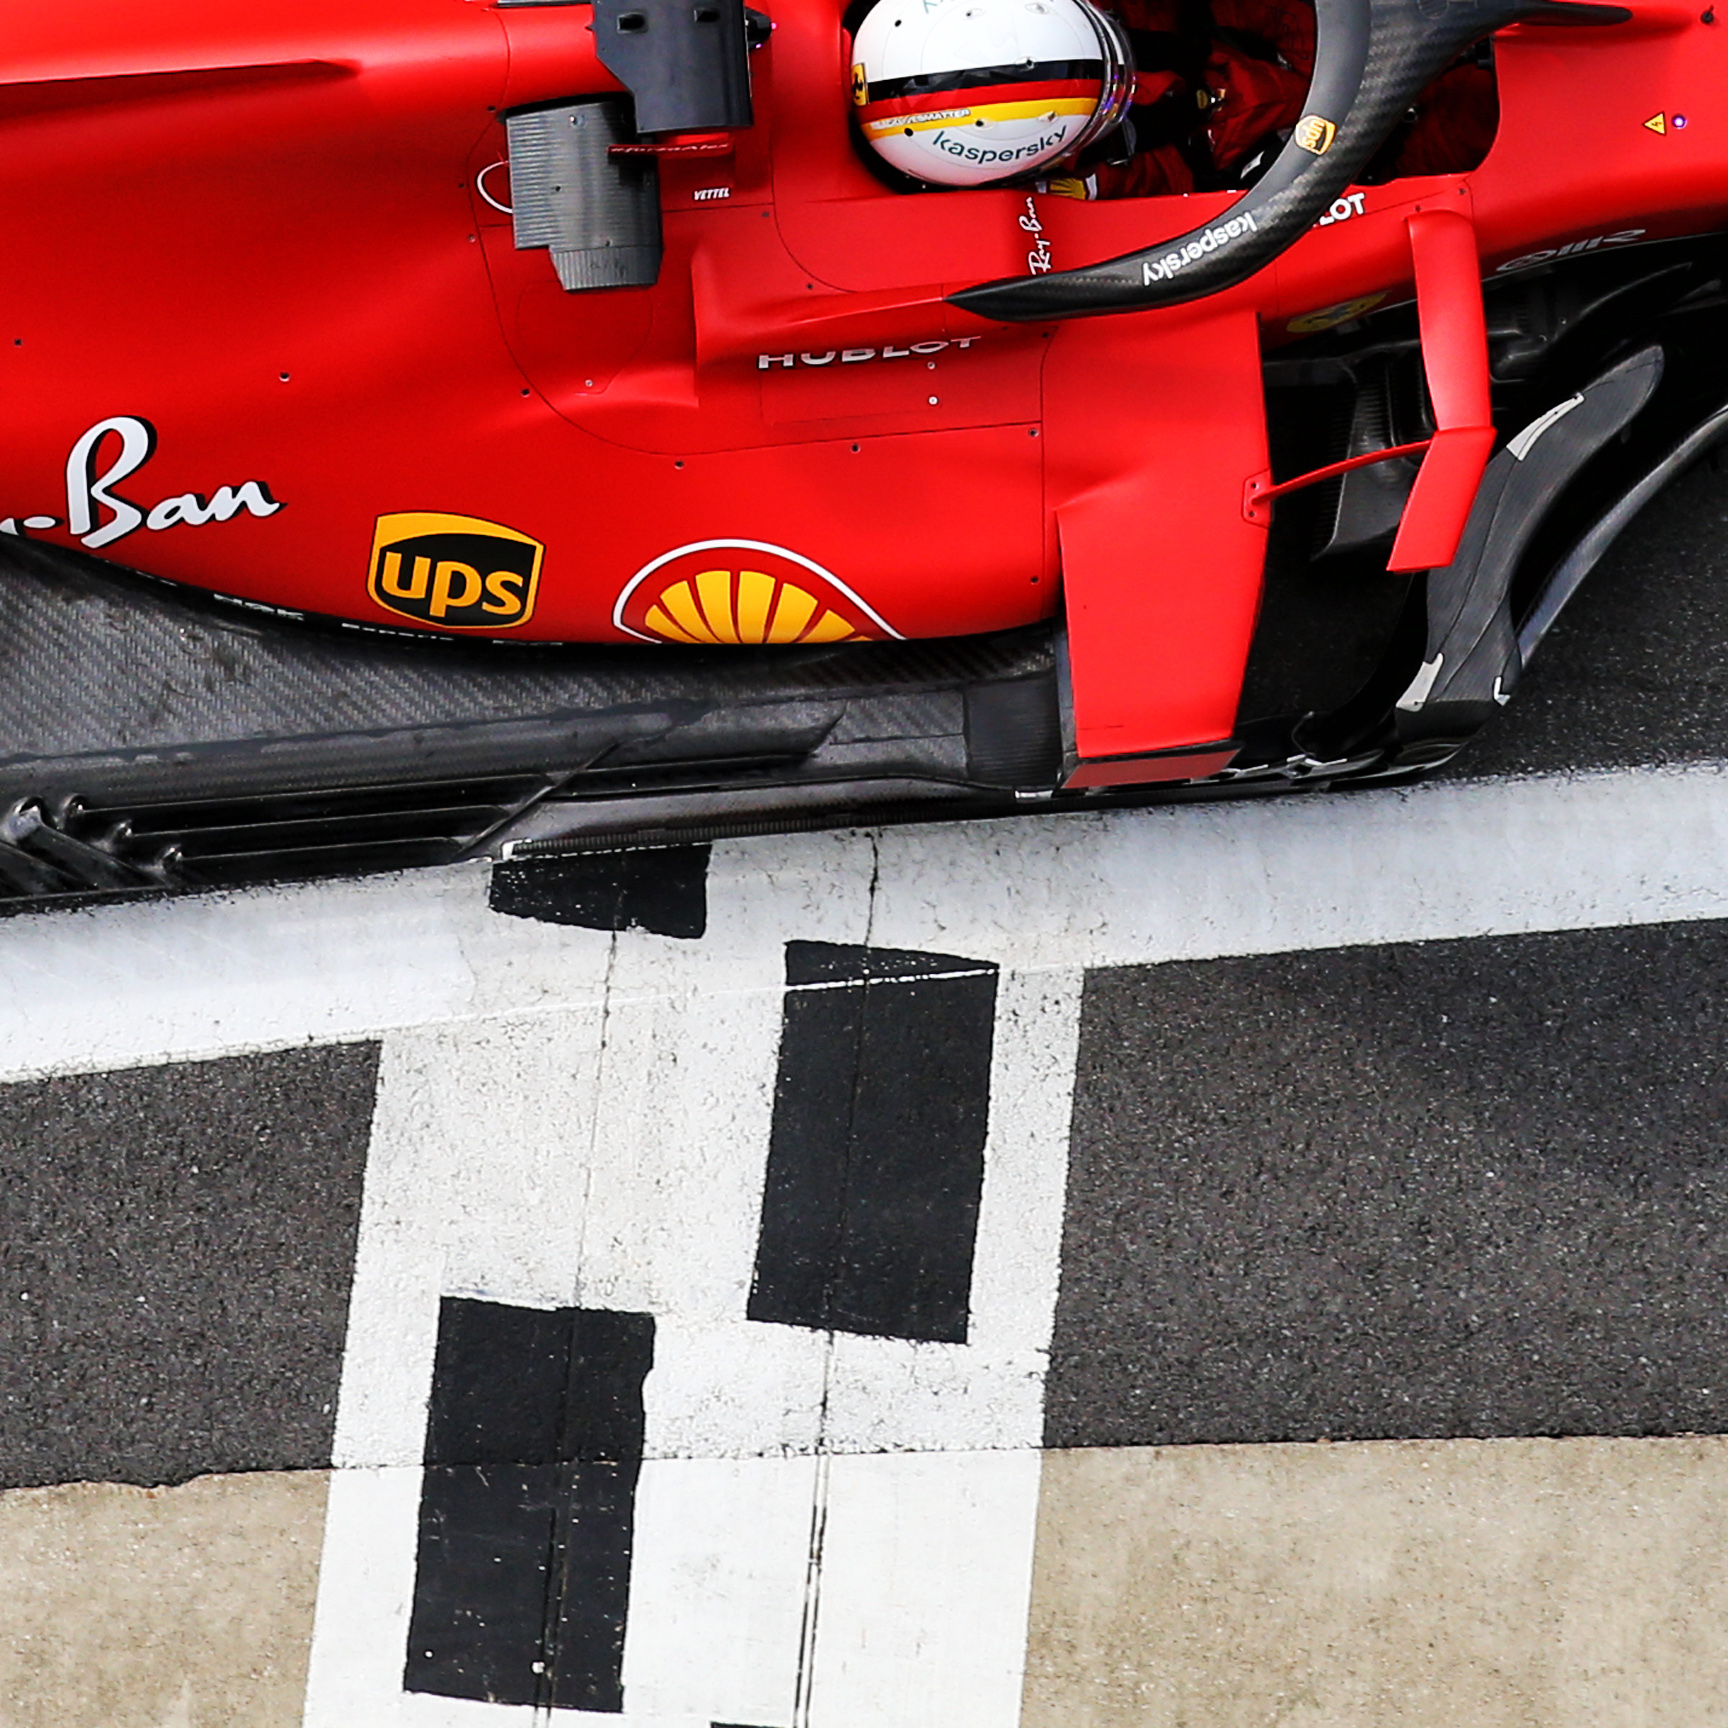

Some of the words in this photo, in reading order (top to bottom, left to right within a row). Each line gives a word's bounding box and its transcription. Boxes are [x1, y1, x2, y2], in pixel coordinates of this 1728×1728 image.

[932, 124, 1067, 165] kaspersky
[1301, 119, 1326, 149] ups
[693, 187, 731, 201] VETTEL
[1018, 196, 1052, 276] Ray-Ban
[1141, 211, 1258, 286] kaspersky
[757, 335, 982, 370] HUBLOT
[381, 550, 524, 618] ups
